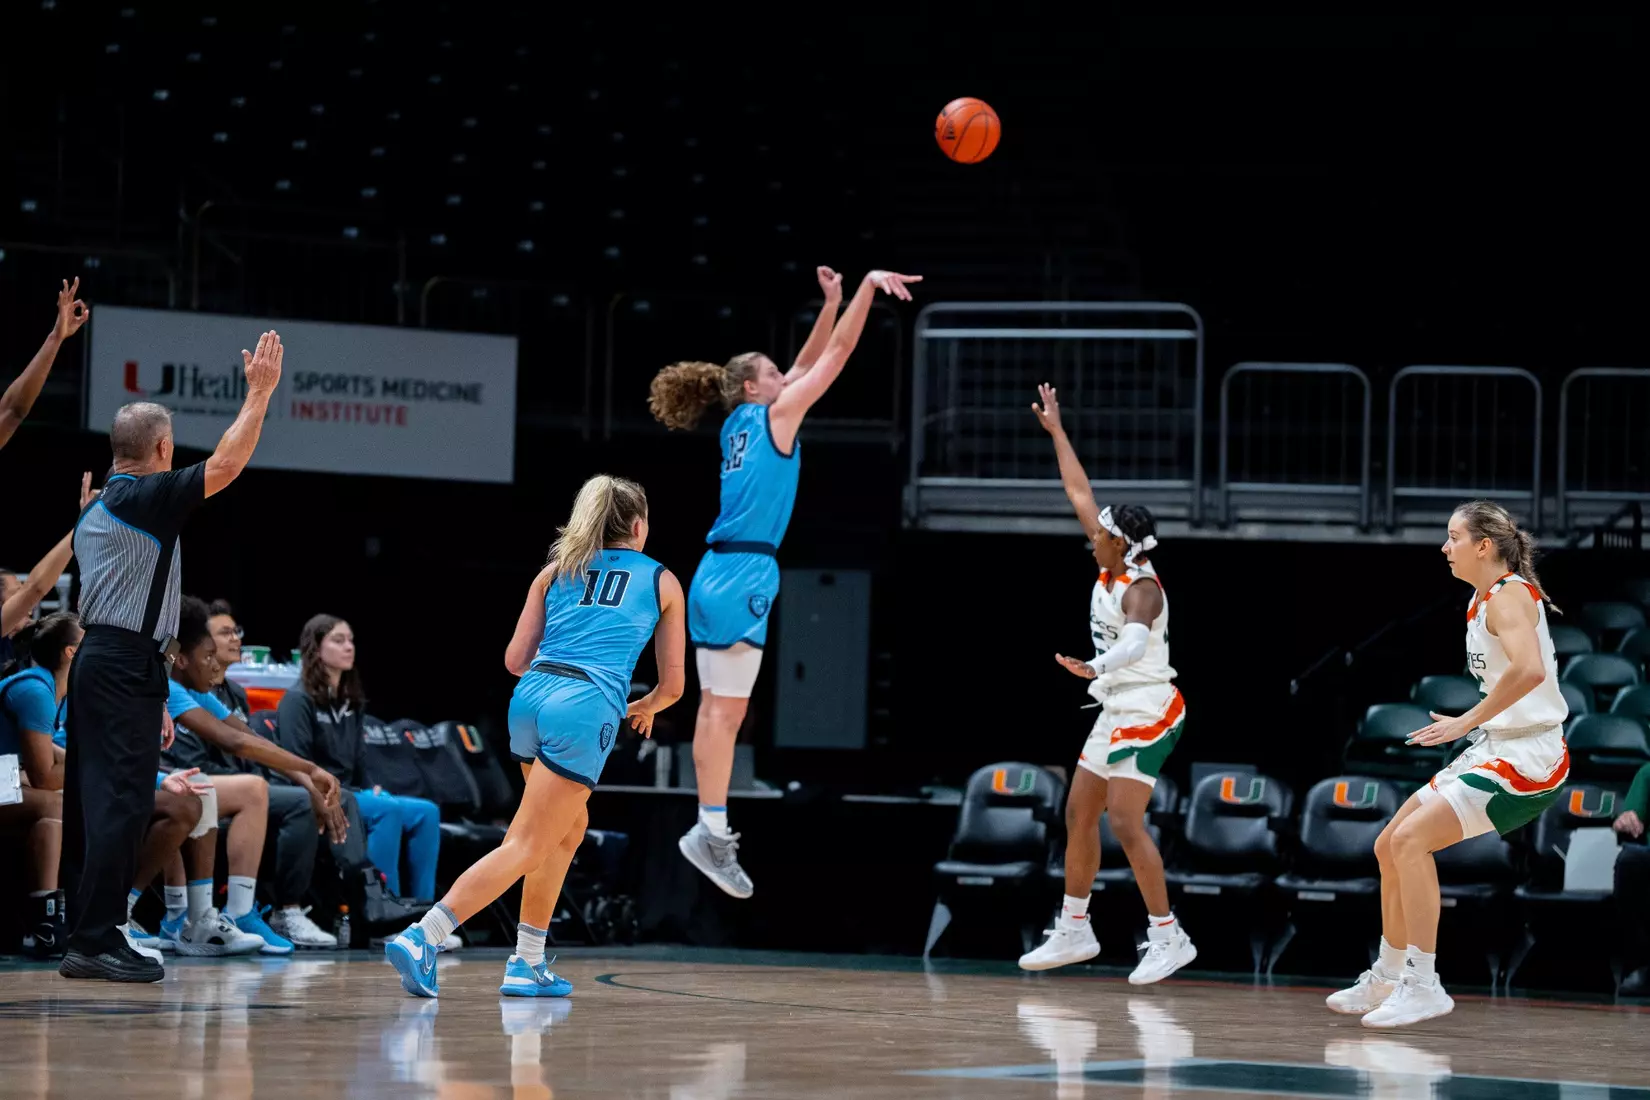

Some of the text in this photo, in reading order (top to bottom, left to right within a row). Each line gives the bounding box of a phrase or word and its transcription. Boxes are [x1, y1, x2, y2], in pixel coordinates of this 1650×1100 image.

[124, 359, 250, 400] UHealt
[293, 371, 483, 405] SPORTS MEDICINE
[290, 399, 409, 427] INSTITUTE
[724, 429, 749, 473] 12
[576, 568, 632, 608] 10
[992, 768, 1037, 796] U
[1220, 777, 1266, 804] U
[1333, 781, 1379, 808] U
[1569, 789, 1616, 818] U
